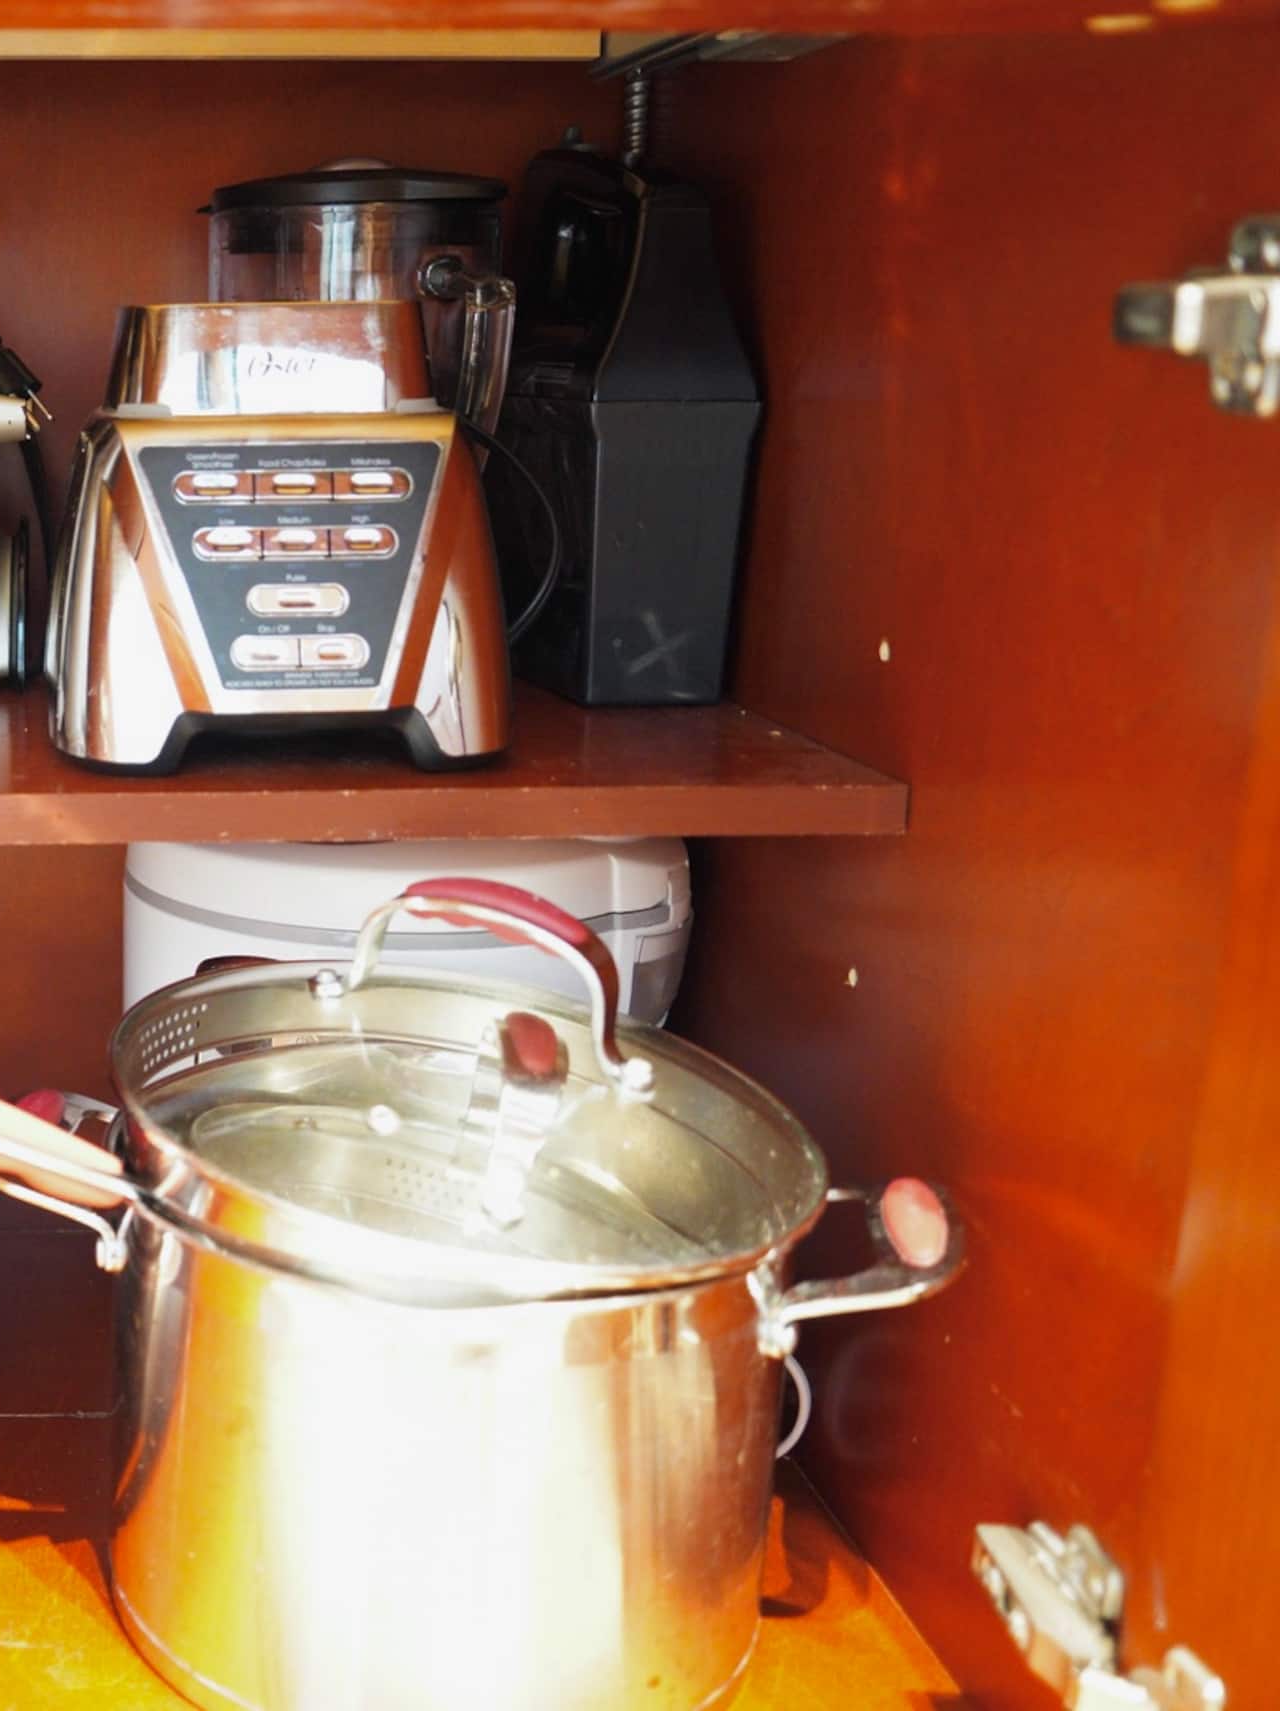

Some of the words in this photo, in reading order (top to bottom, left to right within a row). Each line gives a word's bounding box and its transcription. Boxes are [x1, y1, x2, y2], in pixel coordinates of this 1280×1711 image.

[277, 515, 312, 524] Medium
[351, 514, 370, 524] High
[317, 624, 336, 634] Stop
